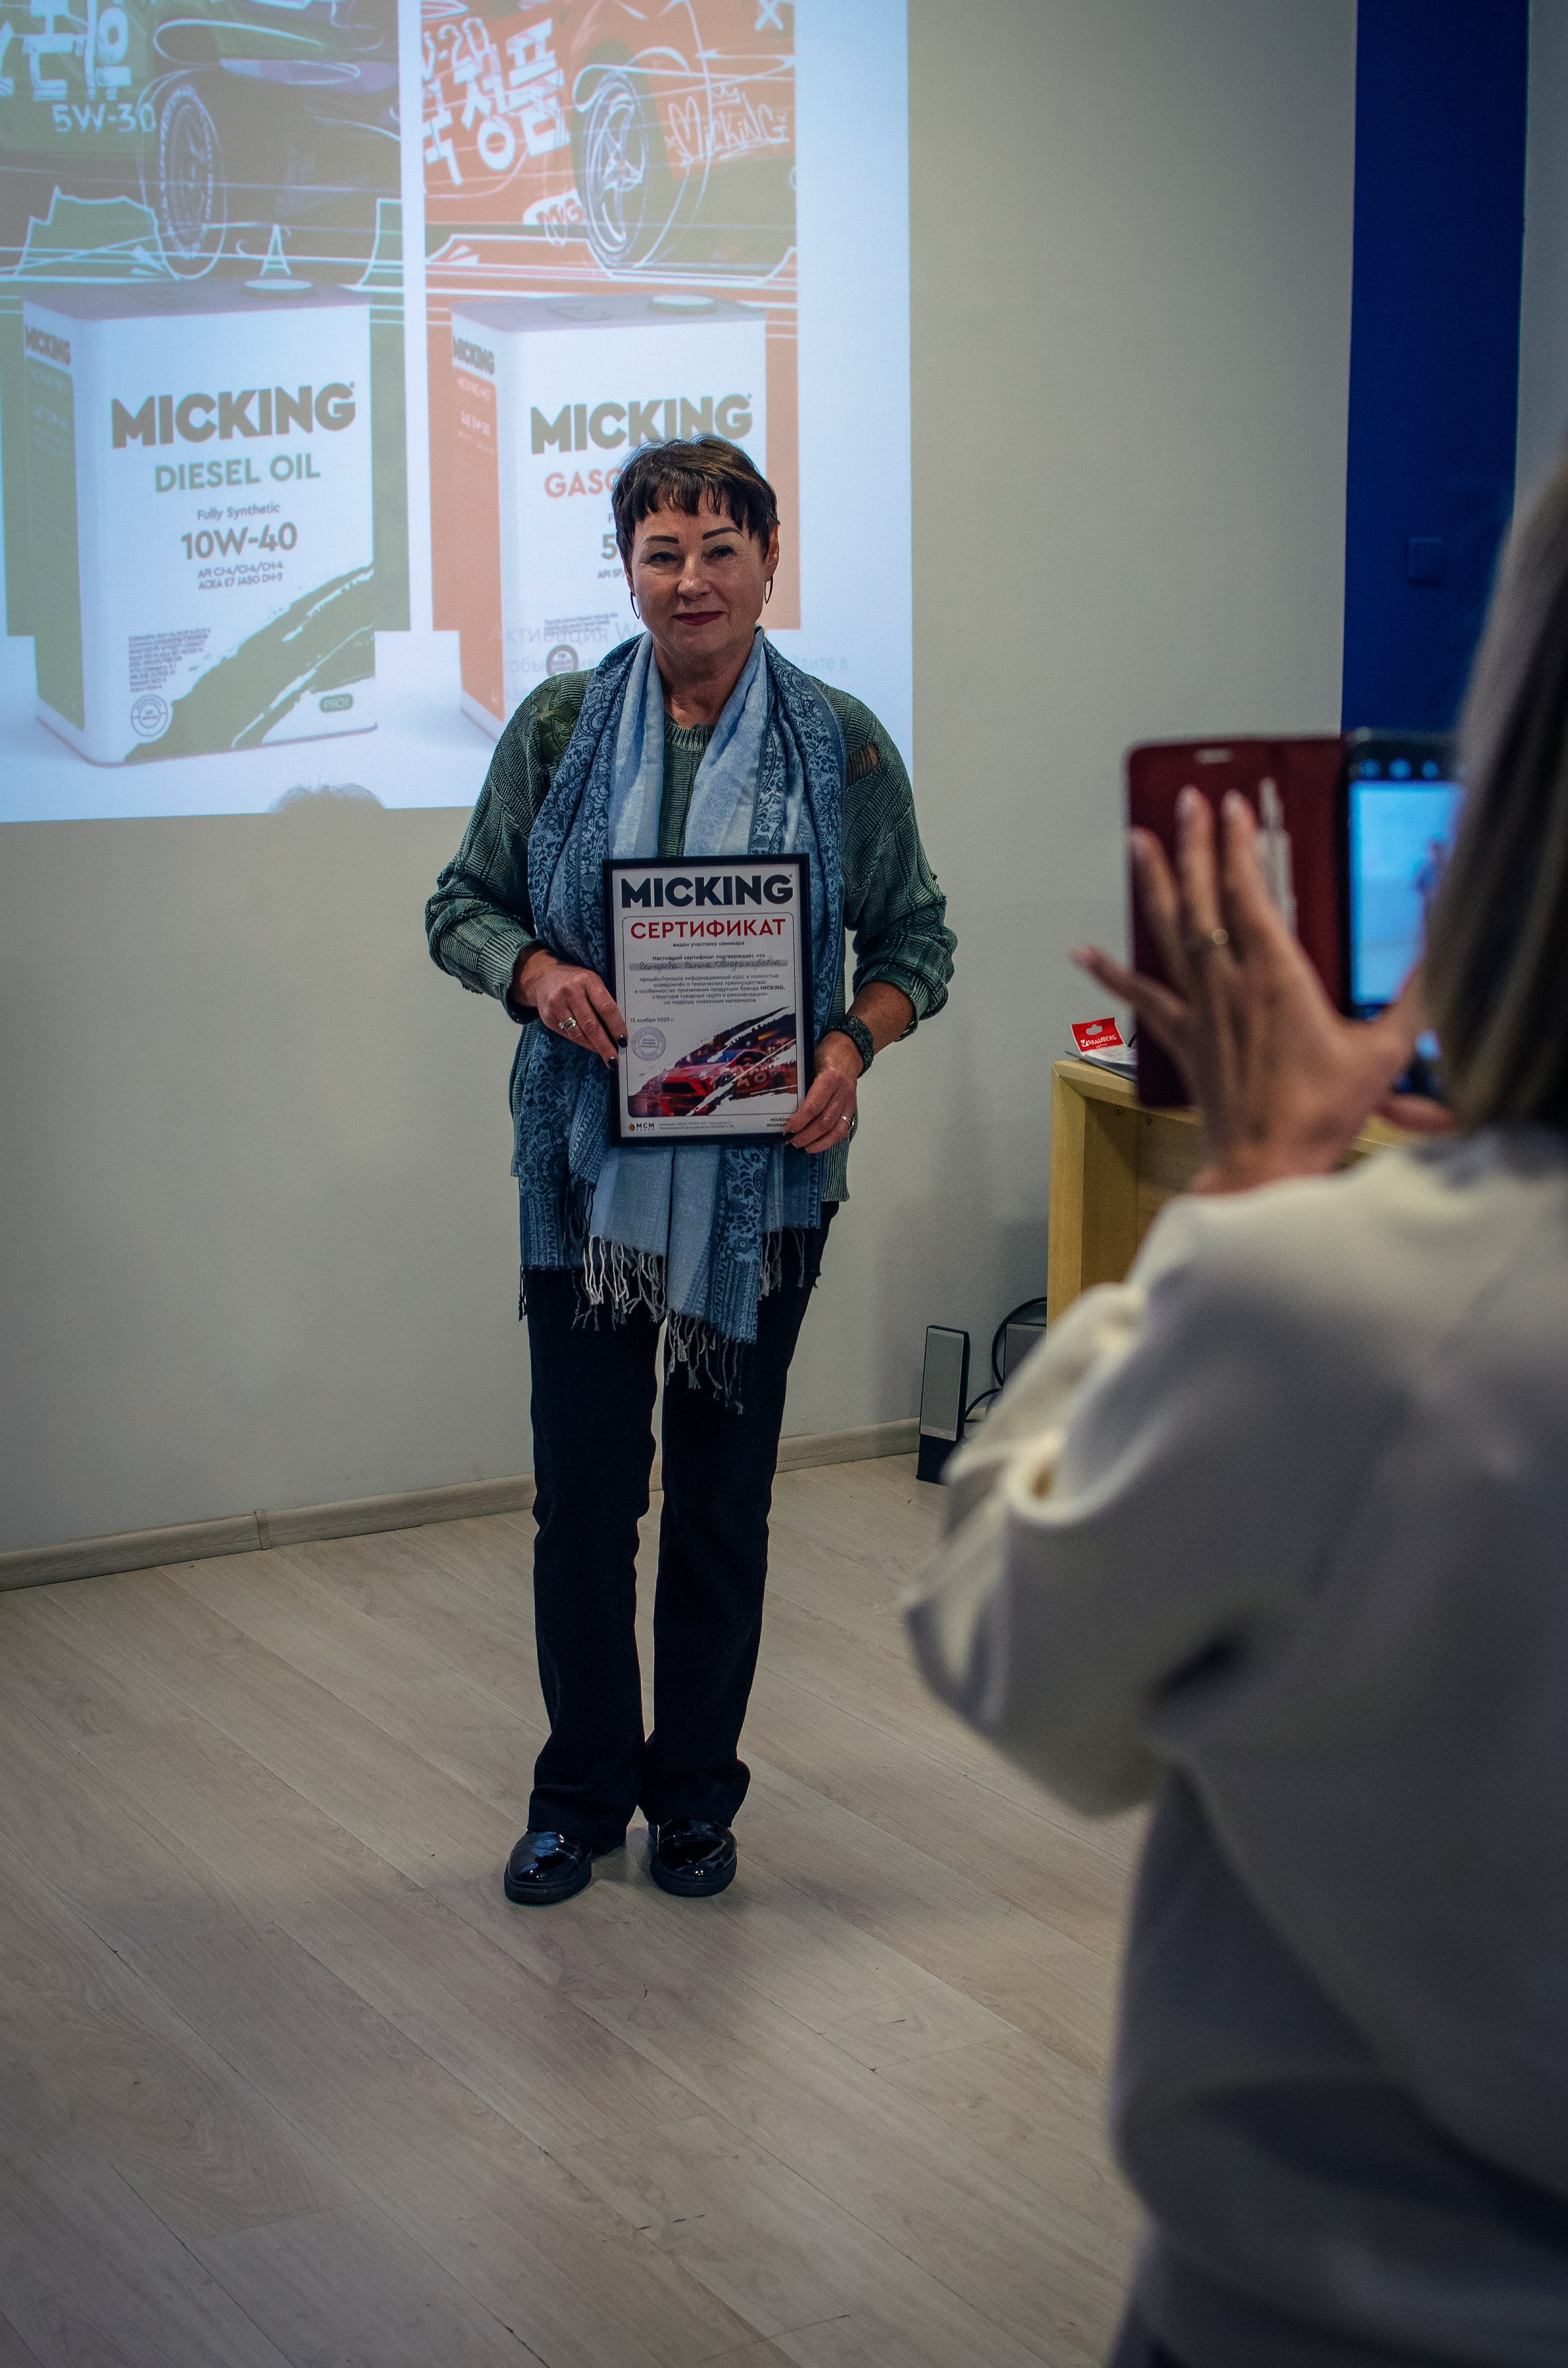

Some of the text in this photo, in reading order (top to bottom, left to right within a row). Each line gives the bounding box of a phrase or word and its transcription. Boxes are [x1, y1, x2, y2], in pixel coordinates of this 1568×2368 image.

[52, 103, 156, 133] 5W-30
[111, 382, 355, 449] MICKING
[530, 394, 752, 455] MICKING
[154, 453, 321, 493] DIESEL OIL
[197, 502, 281, 521] Fully Synthetic
[181, 521, 298, 561] 10W-40
[621, 875, 793, 908] MICKING
[630, 918, 786, 939] СЕРТИФИКАТ
